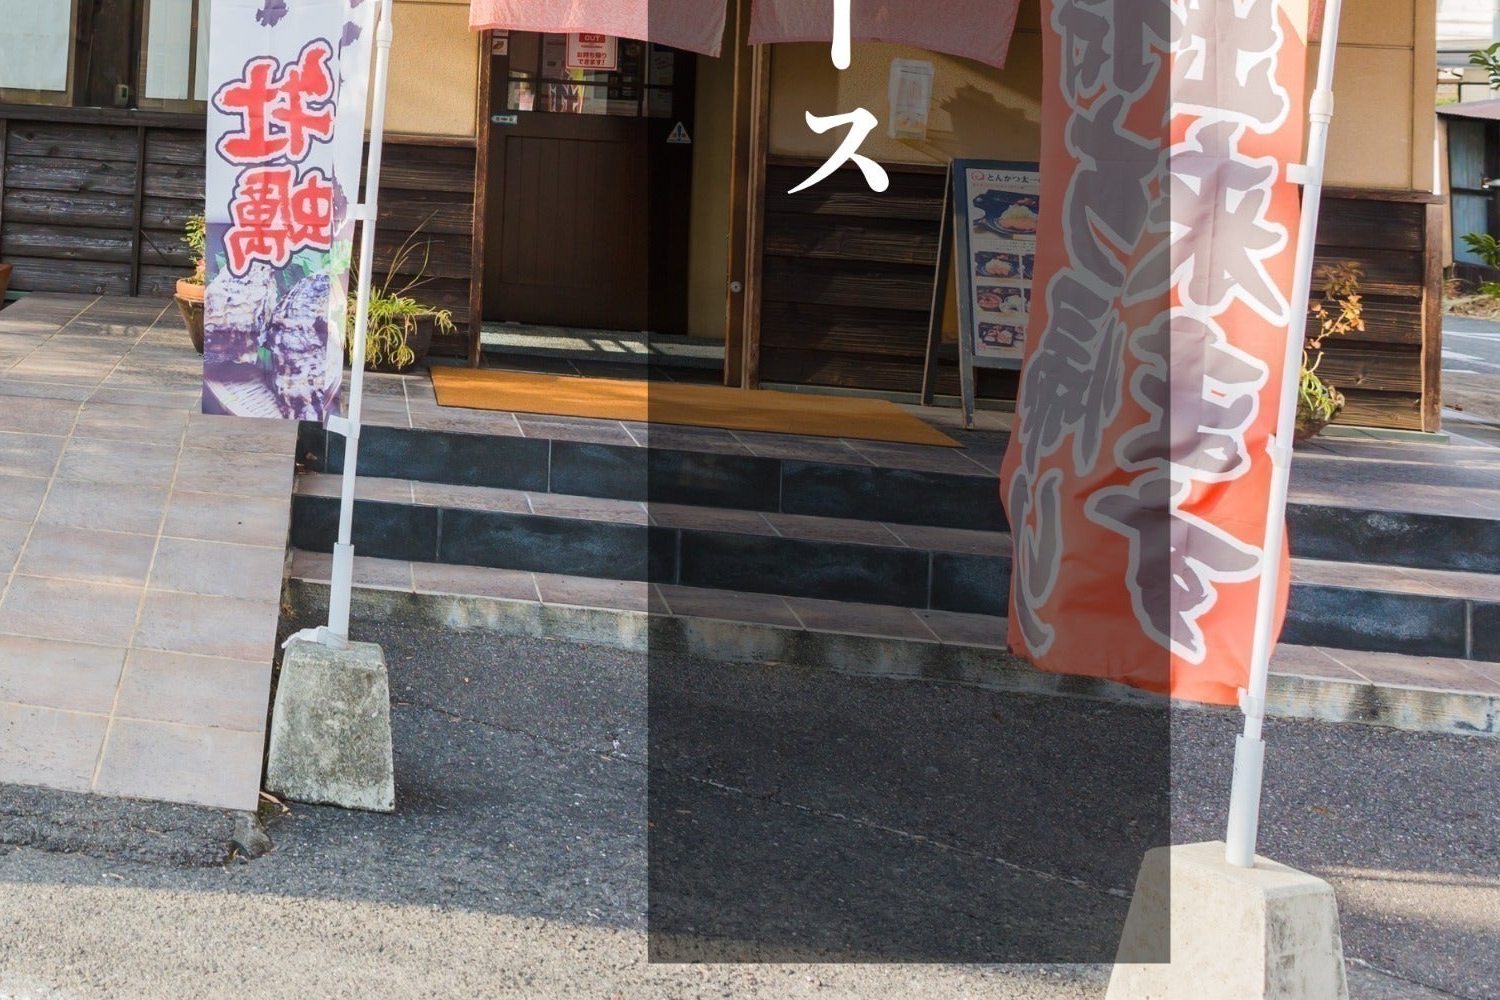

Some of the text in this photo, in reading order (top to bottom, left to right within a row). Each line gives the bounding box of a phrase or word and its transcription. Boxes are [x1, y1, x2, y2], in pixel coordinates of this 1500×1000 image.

[987, 173, 1040, 184] とんかつ太一
